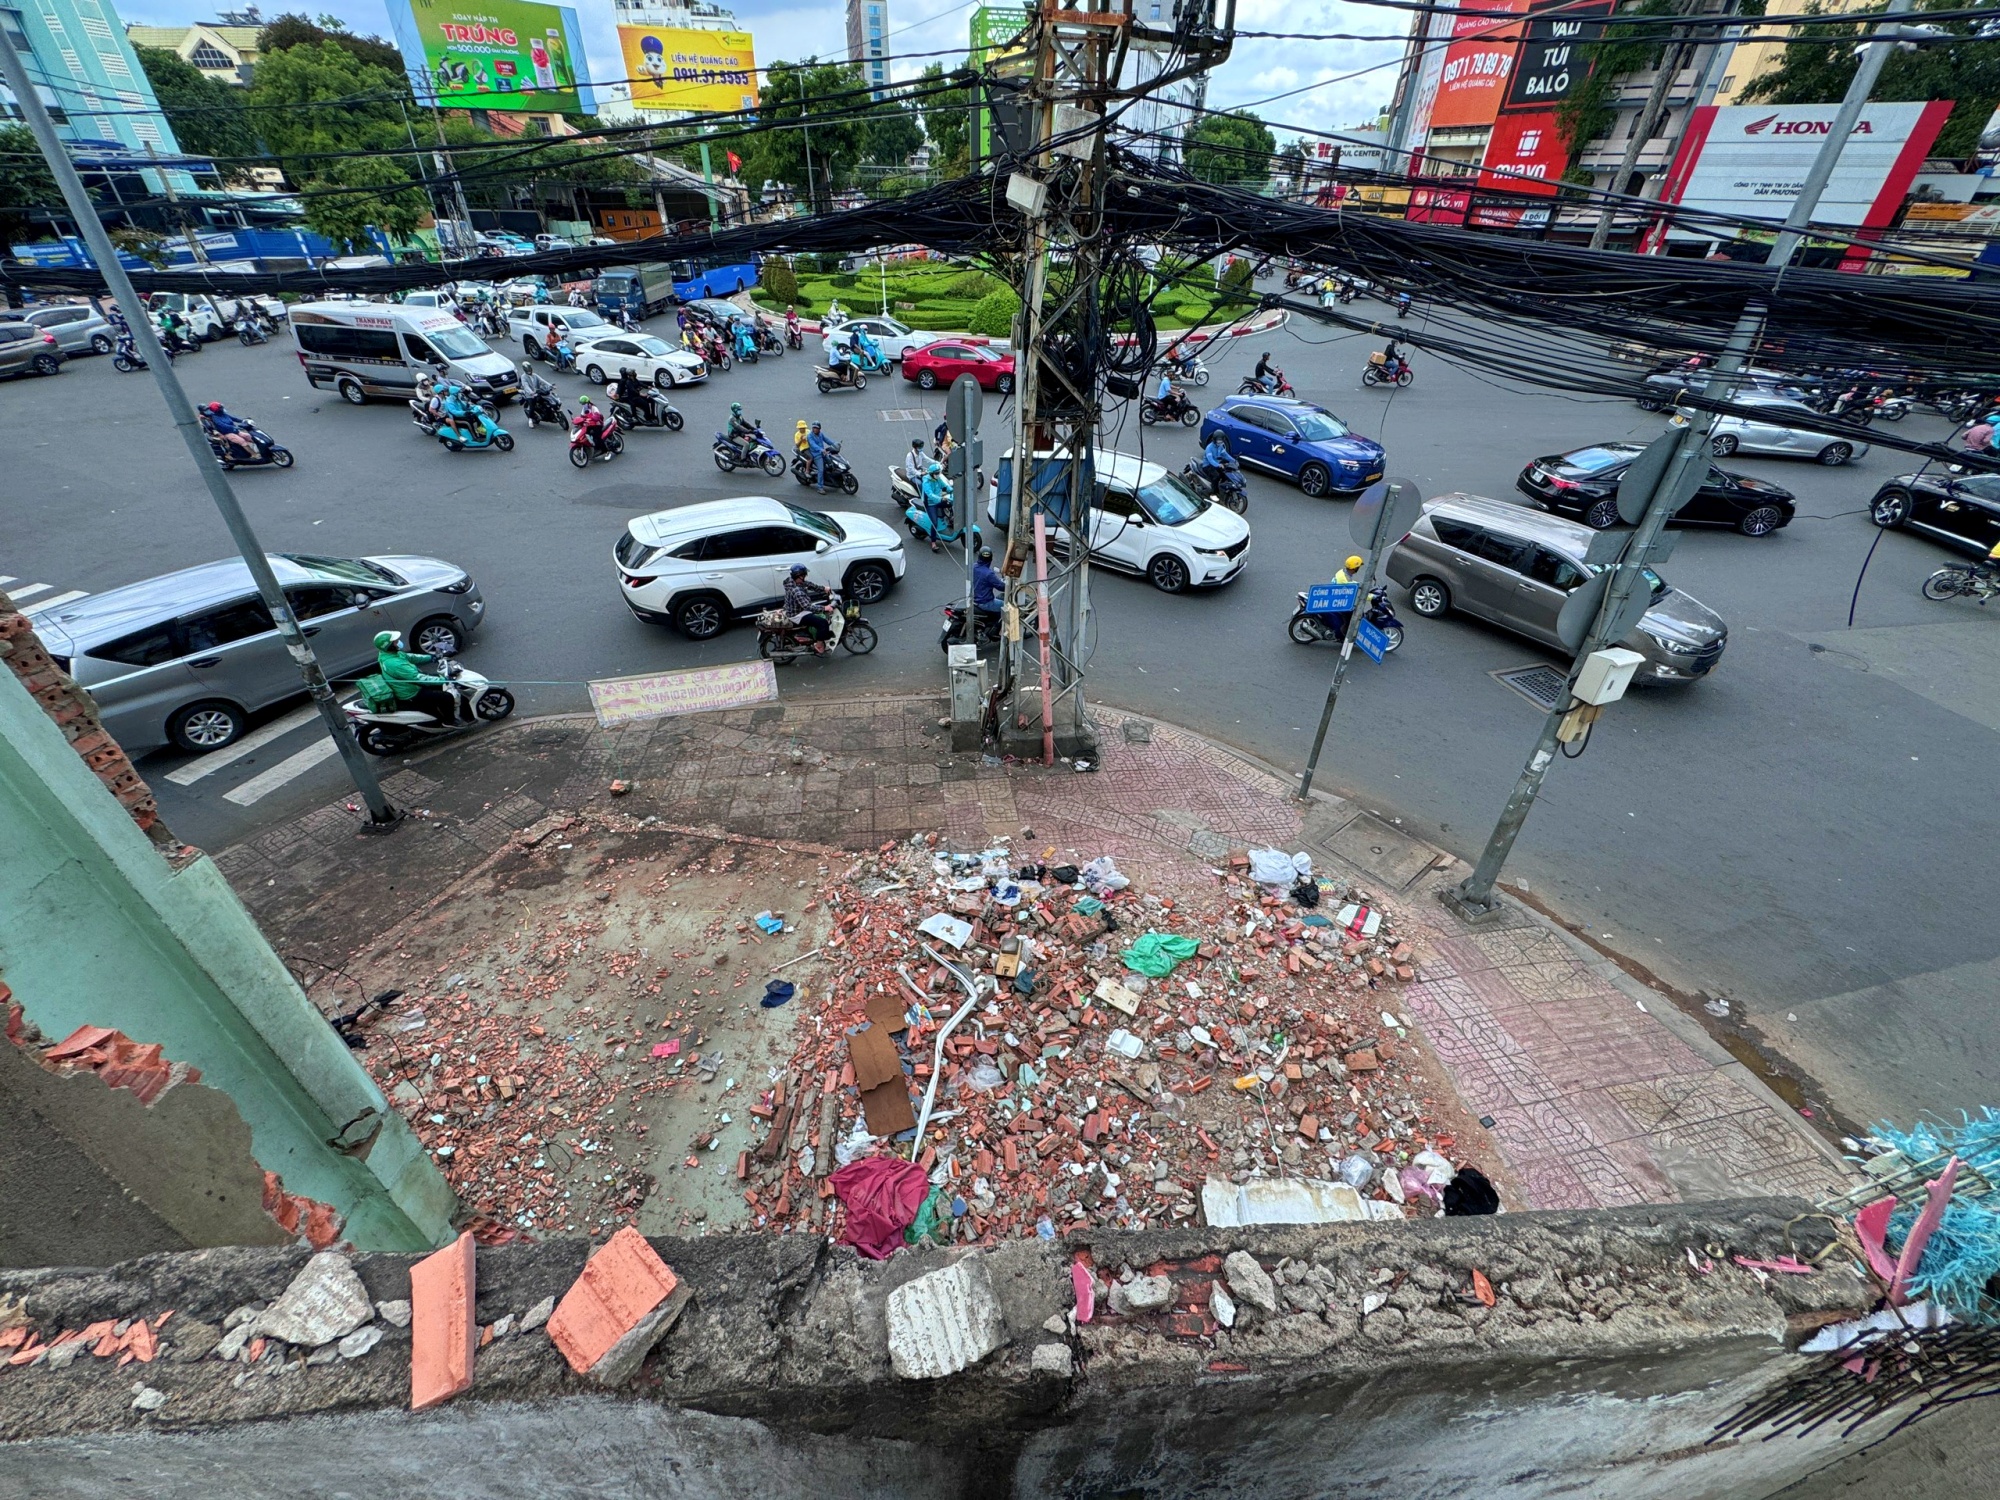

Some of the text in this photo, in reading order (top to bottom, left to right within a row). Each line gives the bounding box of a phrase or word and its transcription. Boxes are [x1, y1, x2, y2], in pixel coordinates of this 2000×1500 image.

[452, 13, 472, 23] XOAY
[488, 16, 498, 24] TH
[1478, 17, 1490, 27] CÁO
[1552, 22, 1581, 37] VALI
[457, 44, 491, 54] 500.000
[1543, 41, 1570, 67] TÚI
[671, 52, 739, 67] LIÊN HỆ QUẢNG CÁO
[1443, 52, 1513, 84] 0971 79 89 79
[673, 66, 749, 85] 0911.39.5555
[1525, 68, 1570, 95] BALÔ
[1449, 81, 1461, 91] LIÊN
[1468, 78, 1485, 88] QUẢNG
[1484, 78, 1496, 88] CÁO
[1771, 121, 1873, 134] HONA
[1331, 149, 1352, 157] SOUL
[1313, 588, 1329, 597] CÔNG
[1312, 595, 1348, 609] DÂN CHỦ
